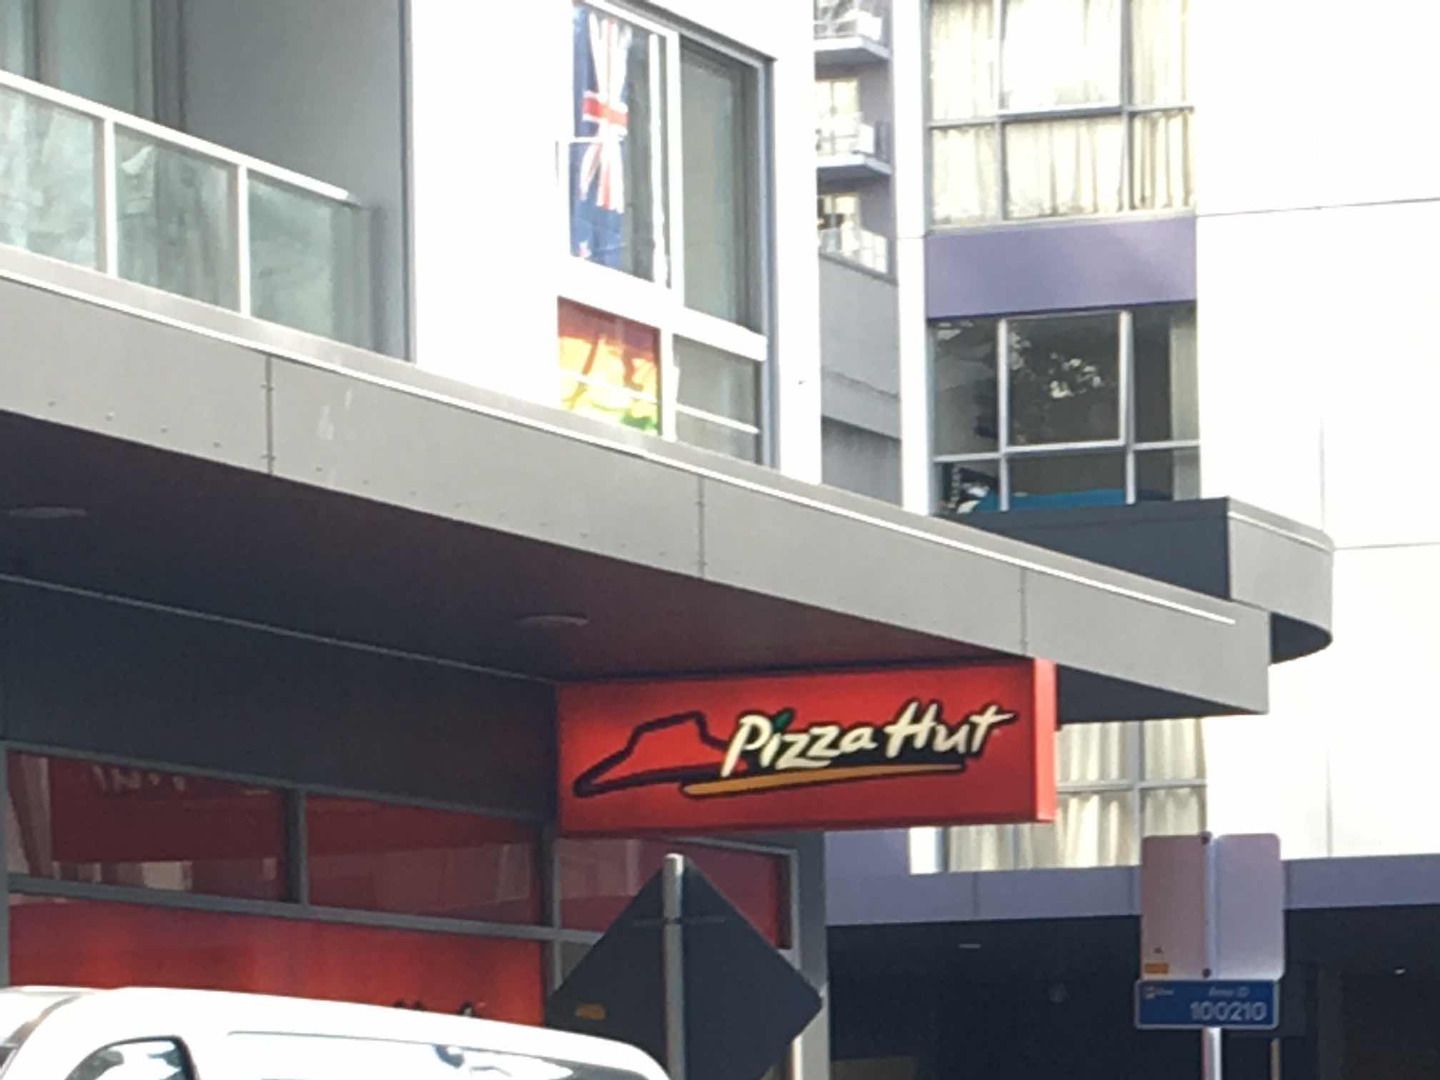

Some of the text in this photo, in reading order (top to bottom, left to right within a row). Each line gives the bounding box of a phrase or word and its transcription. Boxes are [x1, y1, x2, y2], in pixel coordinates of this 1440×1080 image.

[720, 701, 1017, 777] Pizza Hut
[1189, 1001, 1267, 1021] 100210
